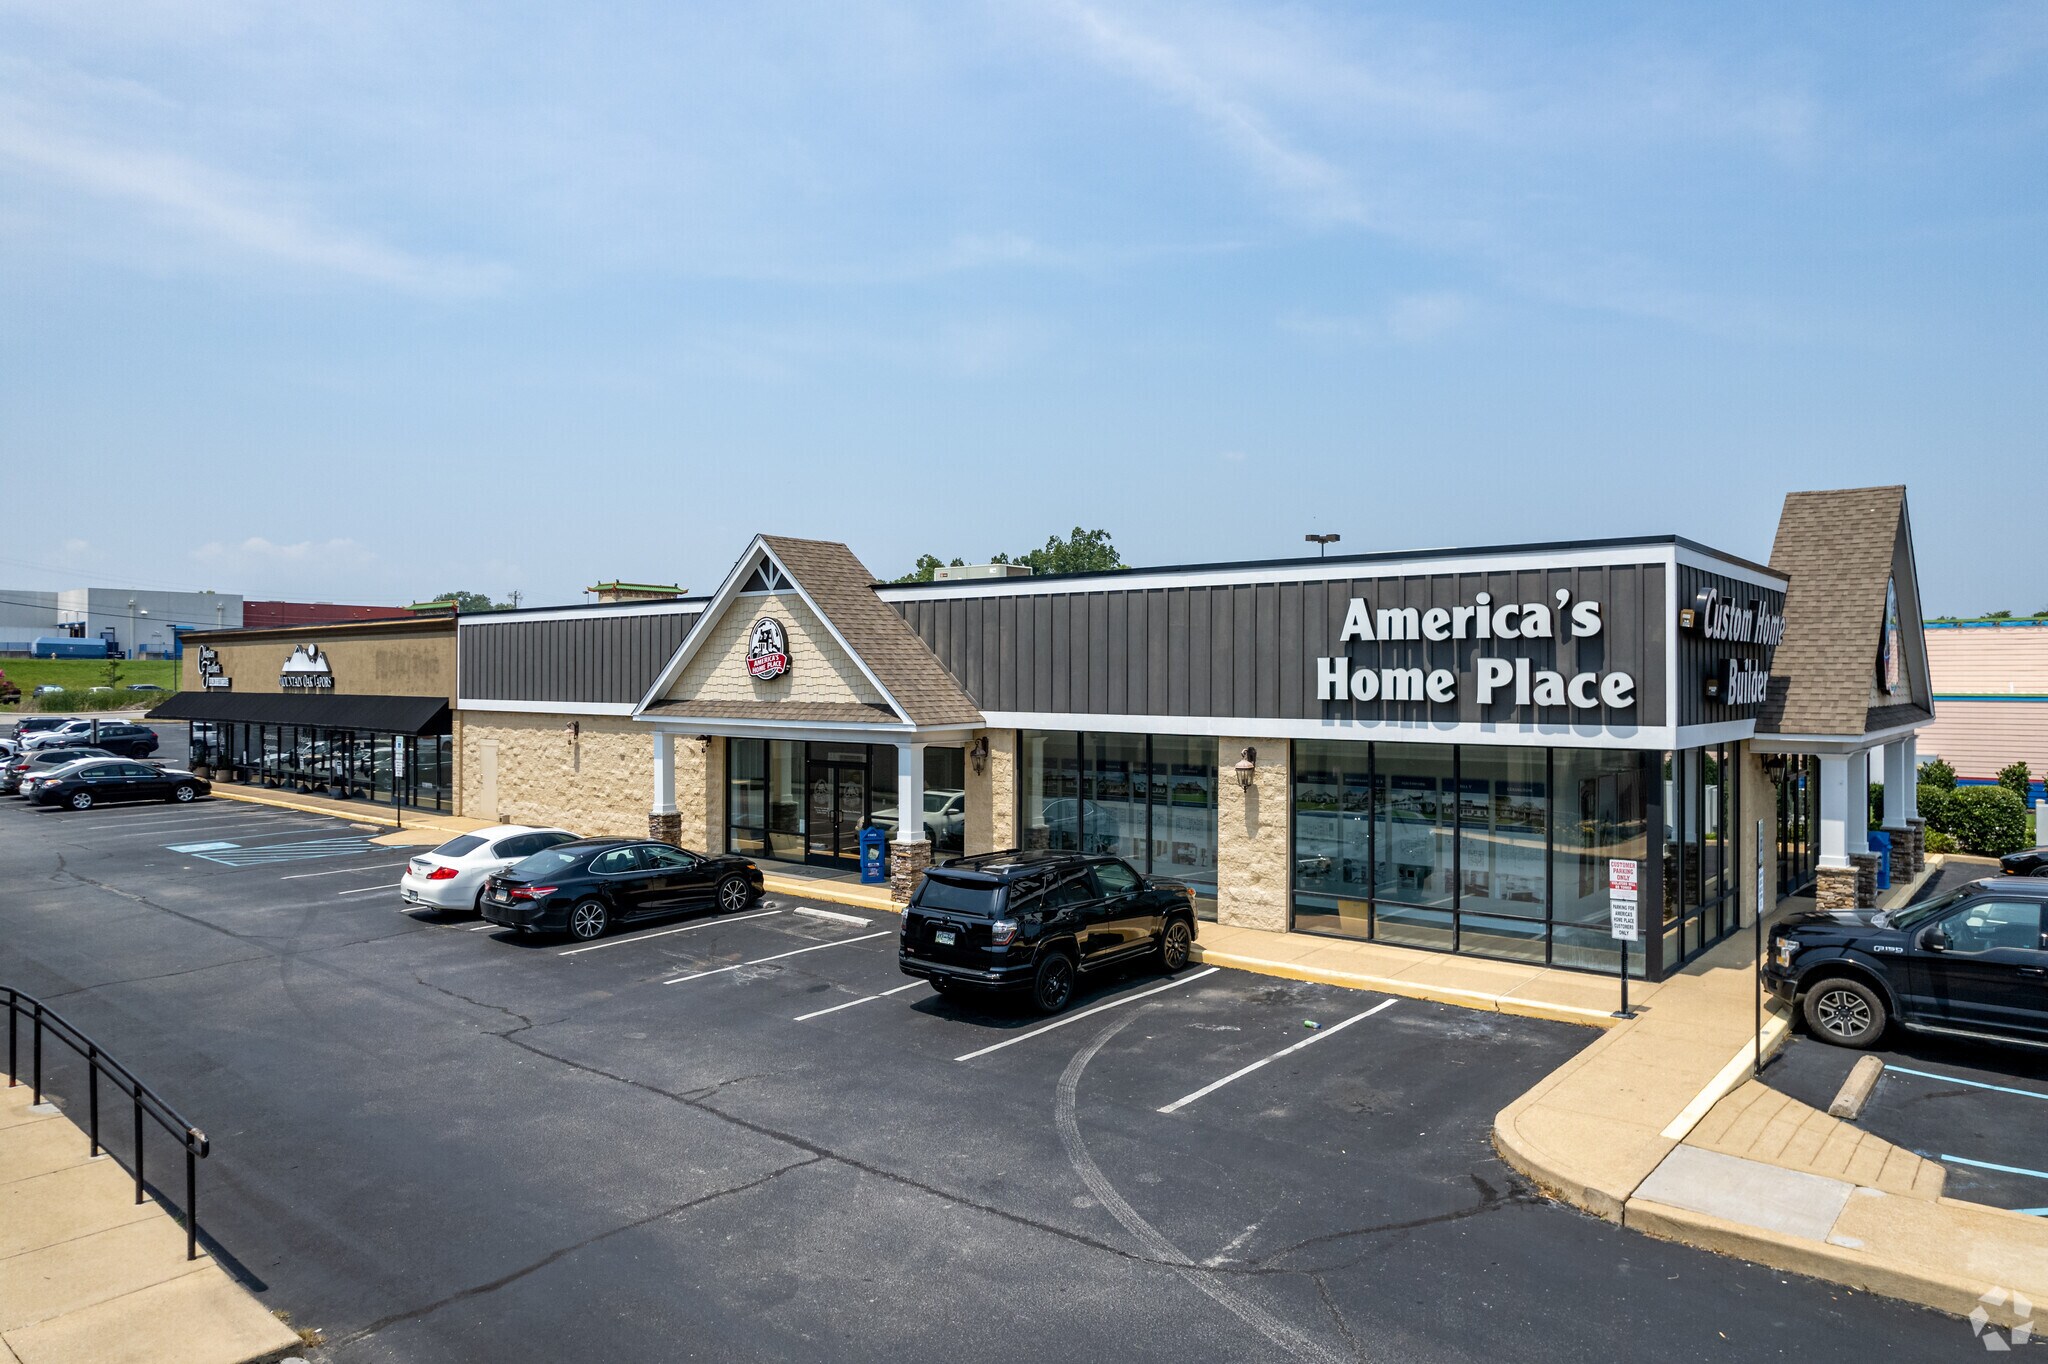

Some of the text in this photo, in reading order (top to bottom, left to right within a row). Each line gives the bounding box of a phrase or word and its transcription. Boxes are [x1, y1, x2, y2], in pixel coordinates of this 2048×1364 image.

[1340, 588, 1602, 642] America's
[1704, 588, 1787, 646] Custom Home
[1317, 657, 1637, 709] Home Place
[1728, 658, 1769, 706] Builder
